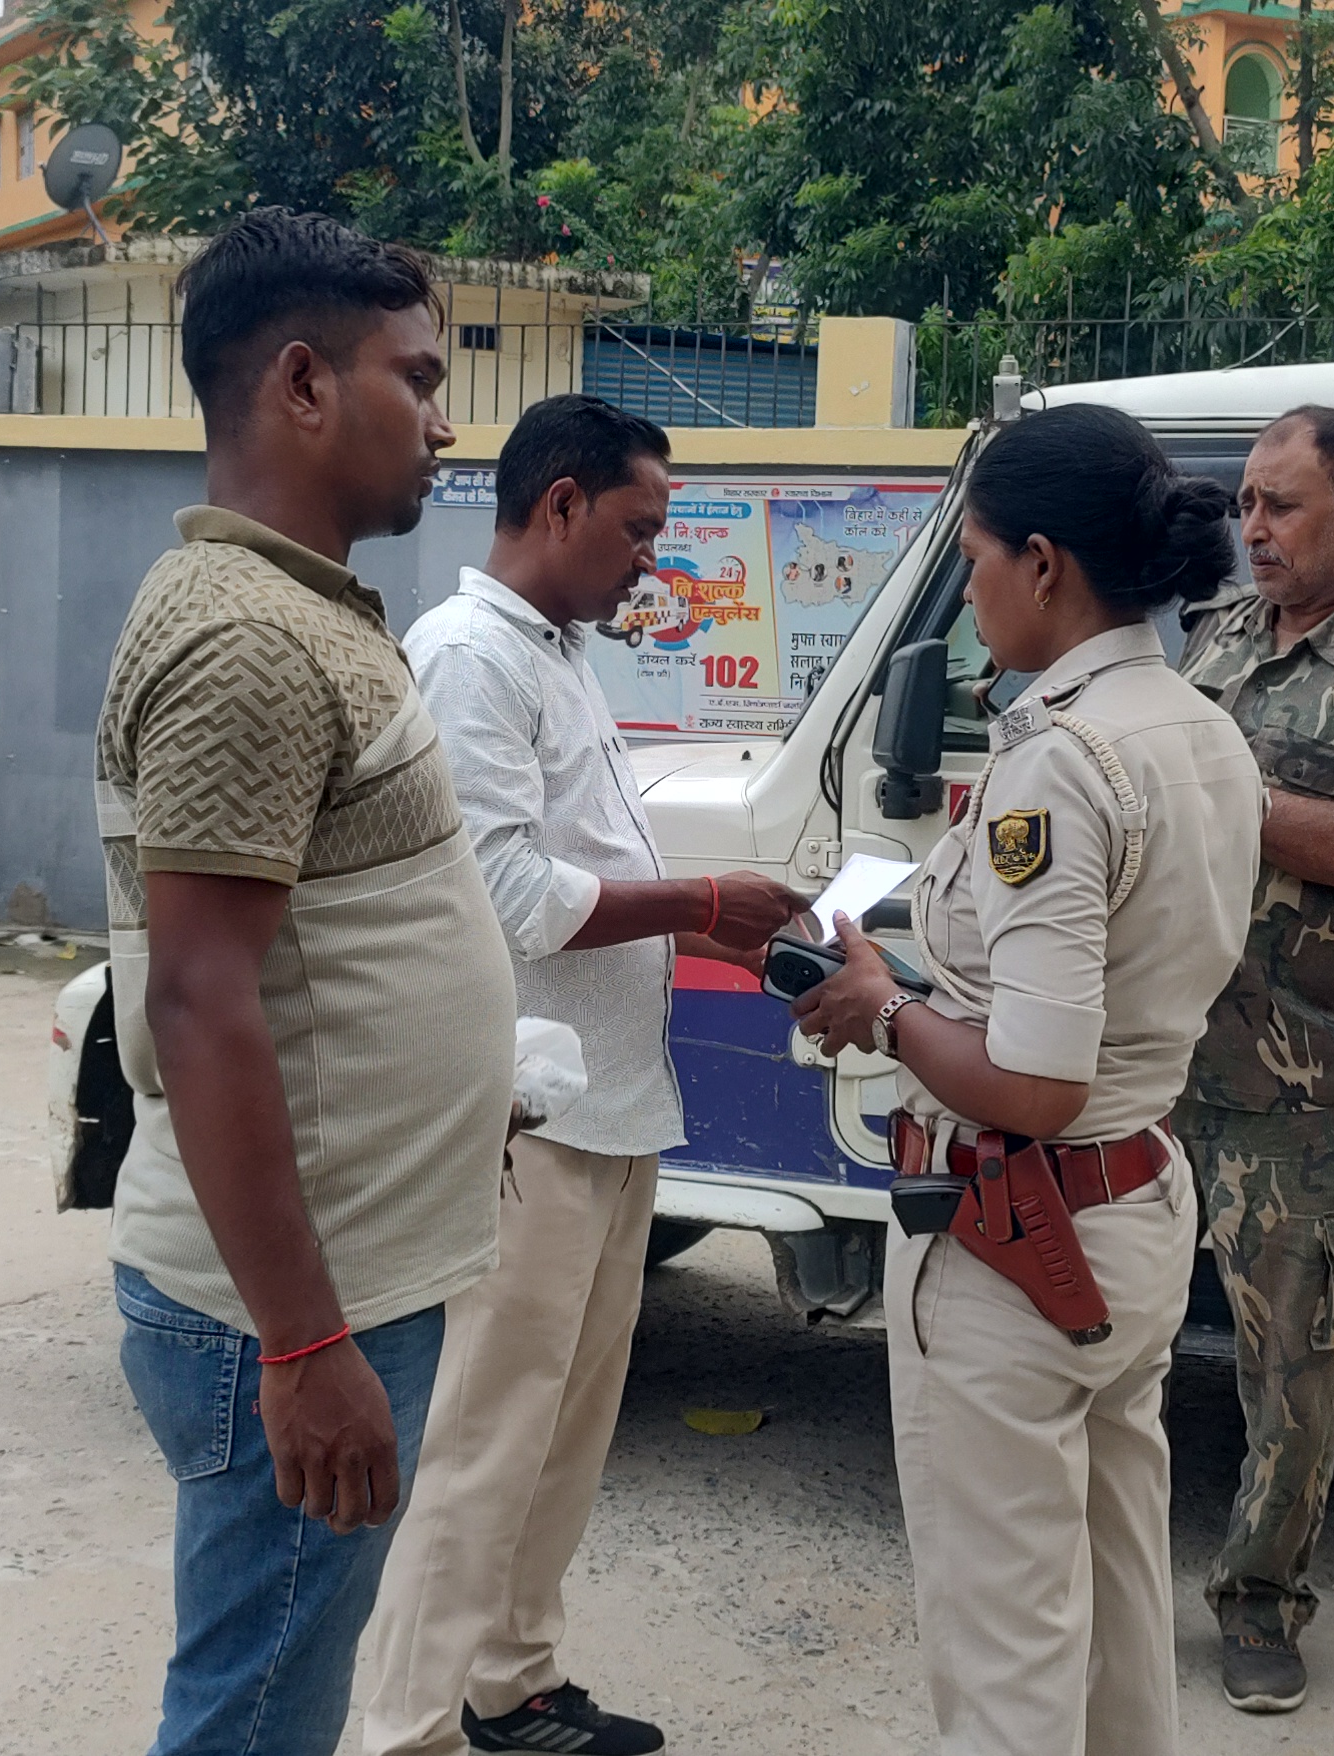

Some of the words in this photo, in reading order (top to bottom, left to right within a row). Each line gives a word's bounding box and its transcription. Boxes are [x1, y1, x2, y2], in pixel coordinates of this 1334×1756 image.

[845, 506, 873, 522] बिहार
[912, 507, 922, 521] से
[699, 654, 760, 689] 102
[699, 718, 723, 729] राज्य
[726, 719, 764, 731] स्वास्थ्य
